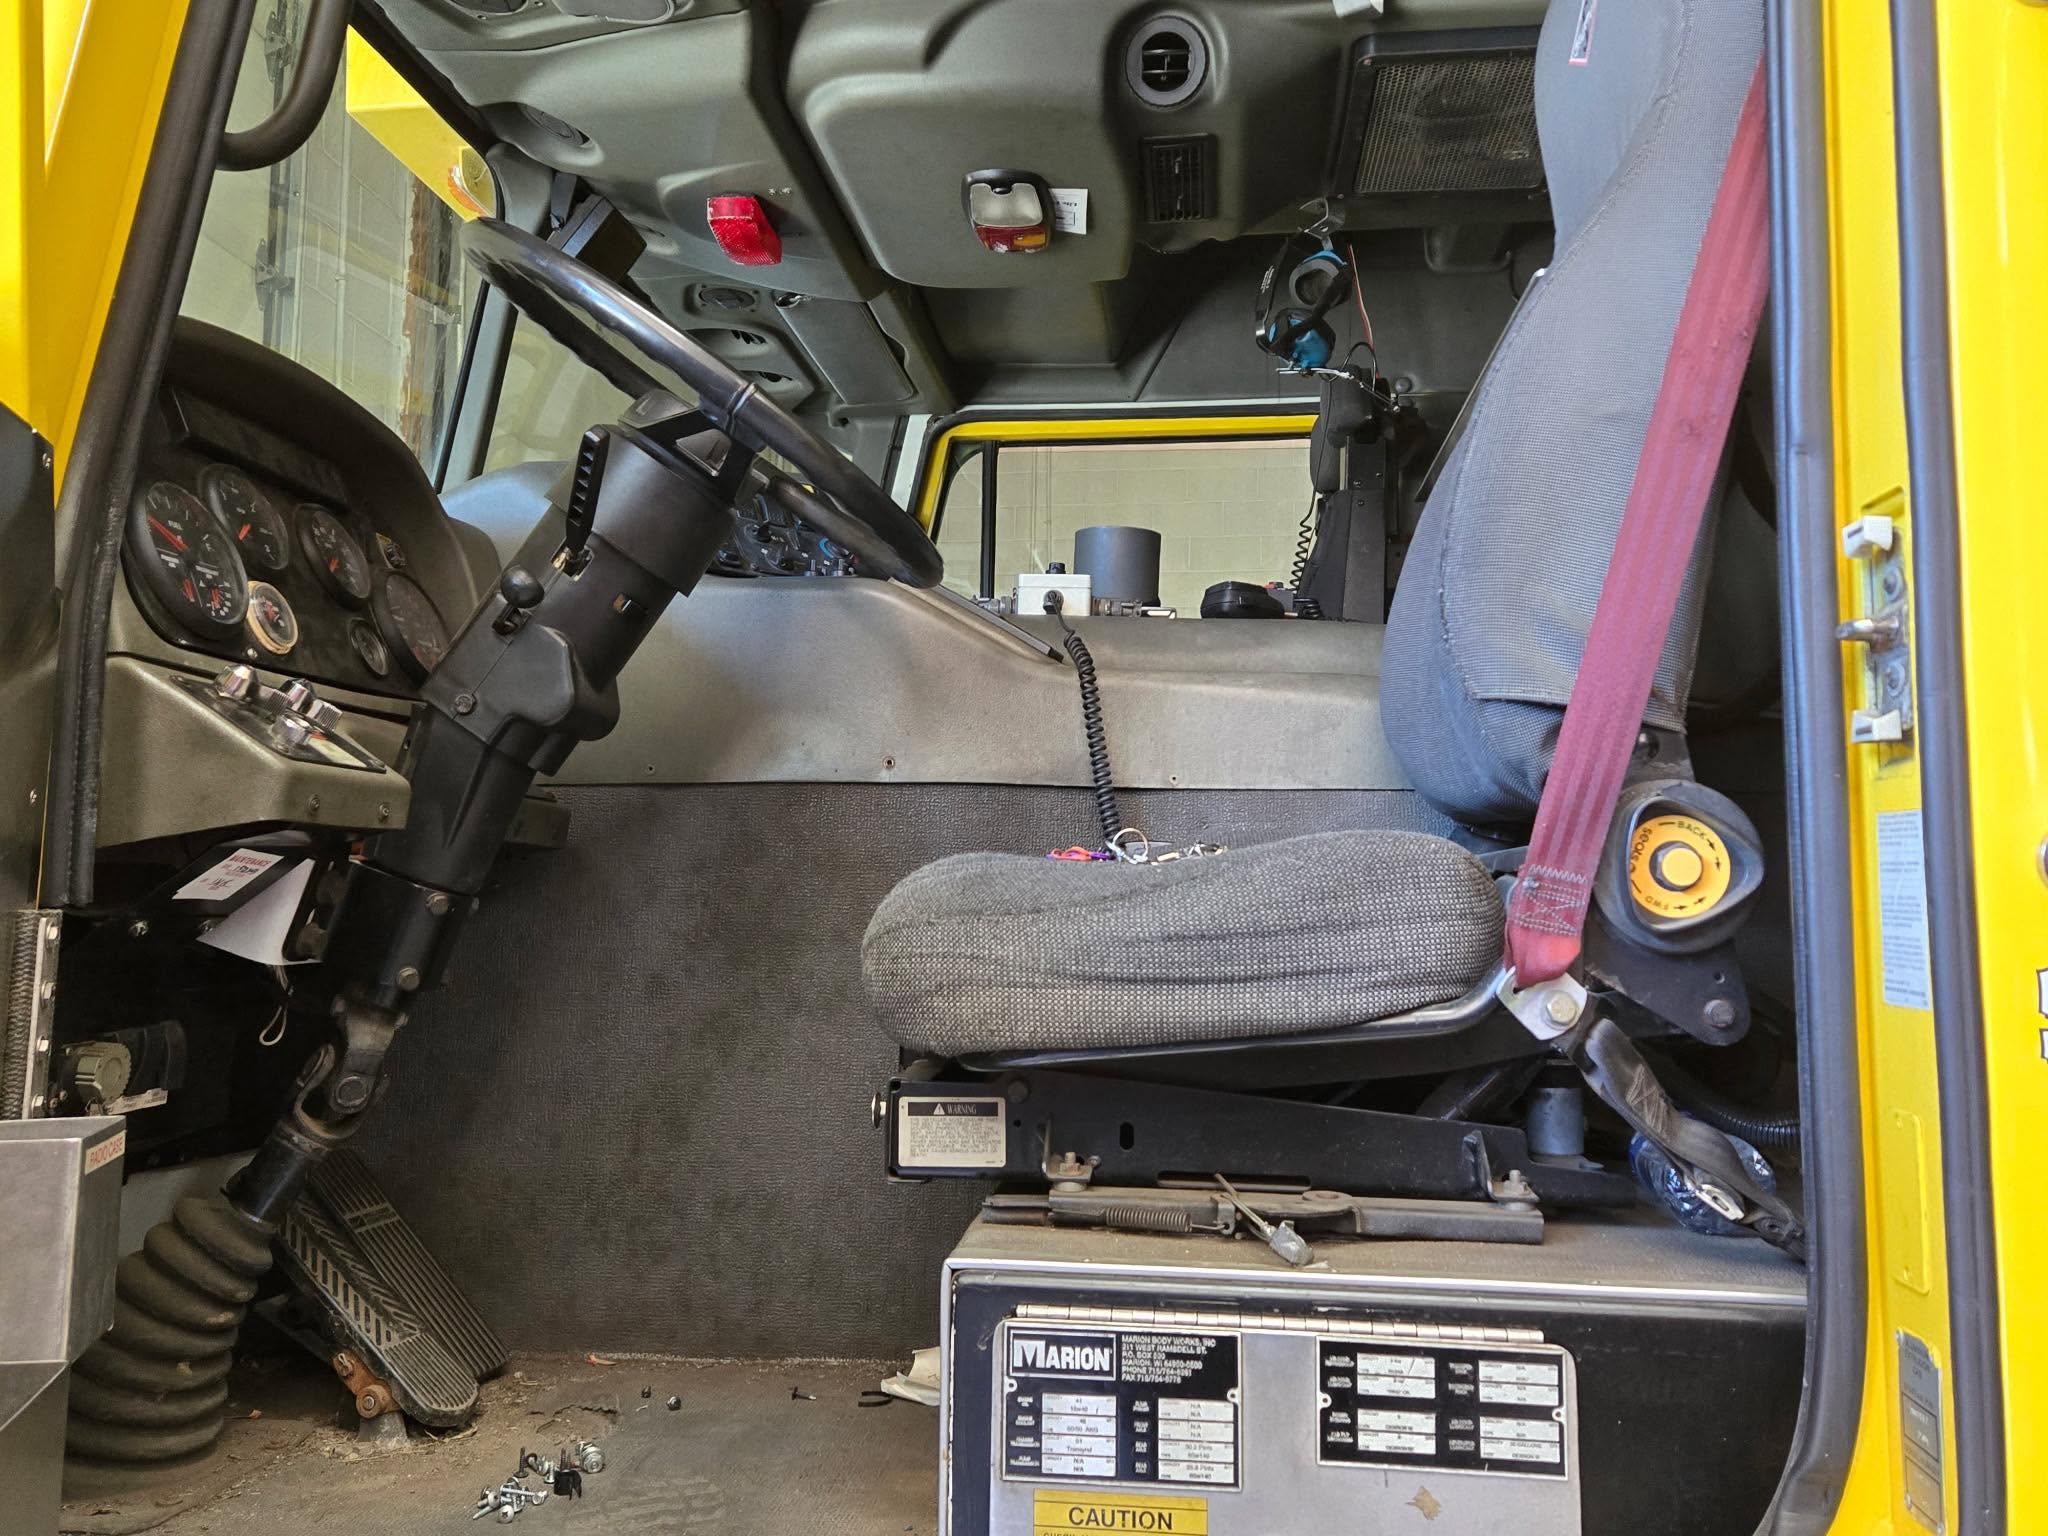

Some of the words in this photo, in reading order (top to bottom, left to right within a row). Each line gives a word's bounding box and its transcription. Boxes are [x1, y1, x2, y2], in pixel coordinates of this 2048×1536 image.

[1678, 821, 1706, 839] BACK
[946, 1104, 976, 1114] WARNING
[90, 1145, 108, 1164] RADIO
[108, 1136, 124, 1157] CASE
[1122, 1335, 1150, 1343] MARION
[1152, 1336, 1172, 1344] BODY
[1013, 1339, 1112, 1371] MARION
[1137, 1352, 1152, 1360] BOX
[1122, 1366, 1146, 1374] PHONE
[1068, 1506, 1172, 1530] CAUTION
